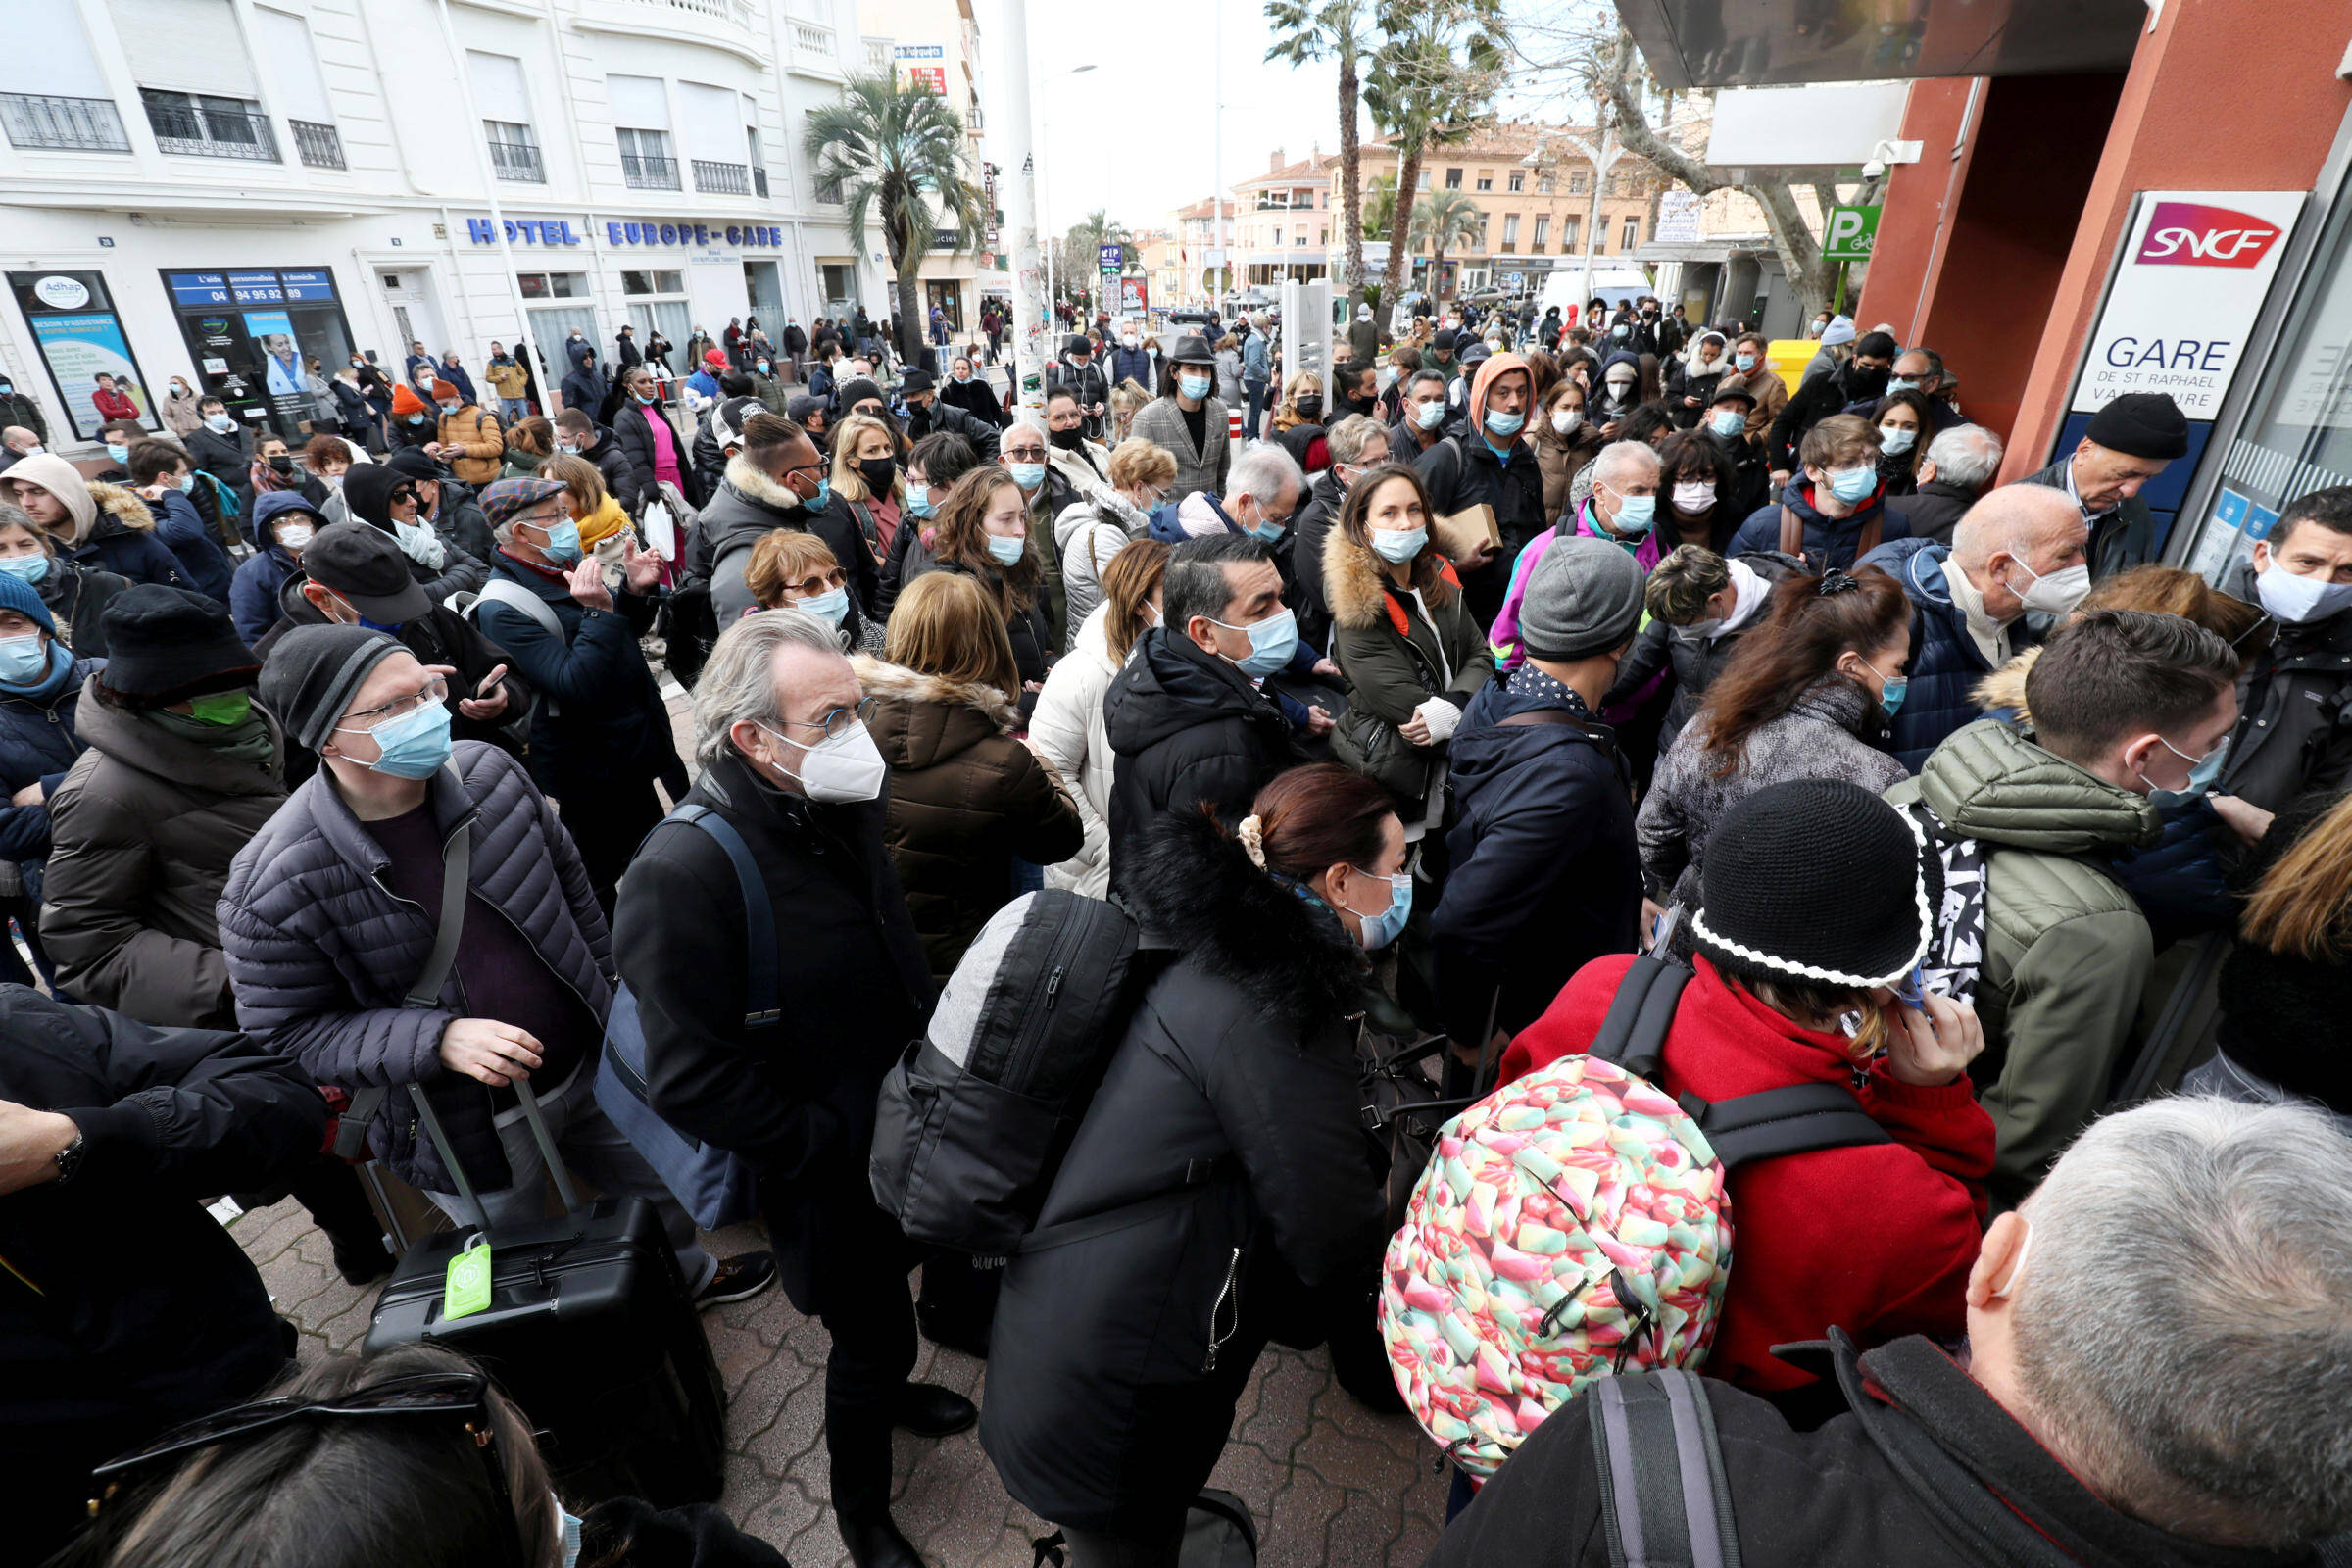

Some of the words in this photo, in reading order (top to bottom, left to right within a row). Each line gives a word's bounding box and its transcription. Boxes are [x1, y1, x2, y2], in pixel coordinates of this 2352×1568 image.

[466, 218, 581, 244] HOTEL
[1830, 212, 1863, 250] P
[2143, 227, 2274, 260] SNCF
[46, 282, 82, 293] Adhap
[211, 291, 227, 302] 04
[236, 290, 251, 300] 94
[253, 289, 268, 300] 95
[269, 288, 283, 299] 92
[287, 288, 302, 298] 89
[2107, 337, 2230, 371] GARE
[2097, 370, 2117, 383] DE
[2123, 372, 2143, 384] ST
[2148, 373, 2216, 388] RAPHAEL
